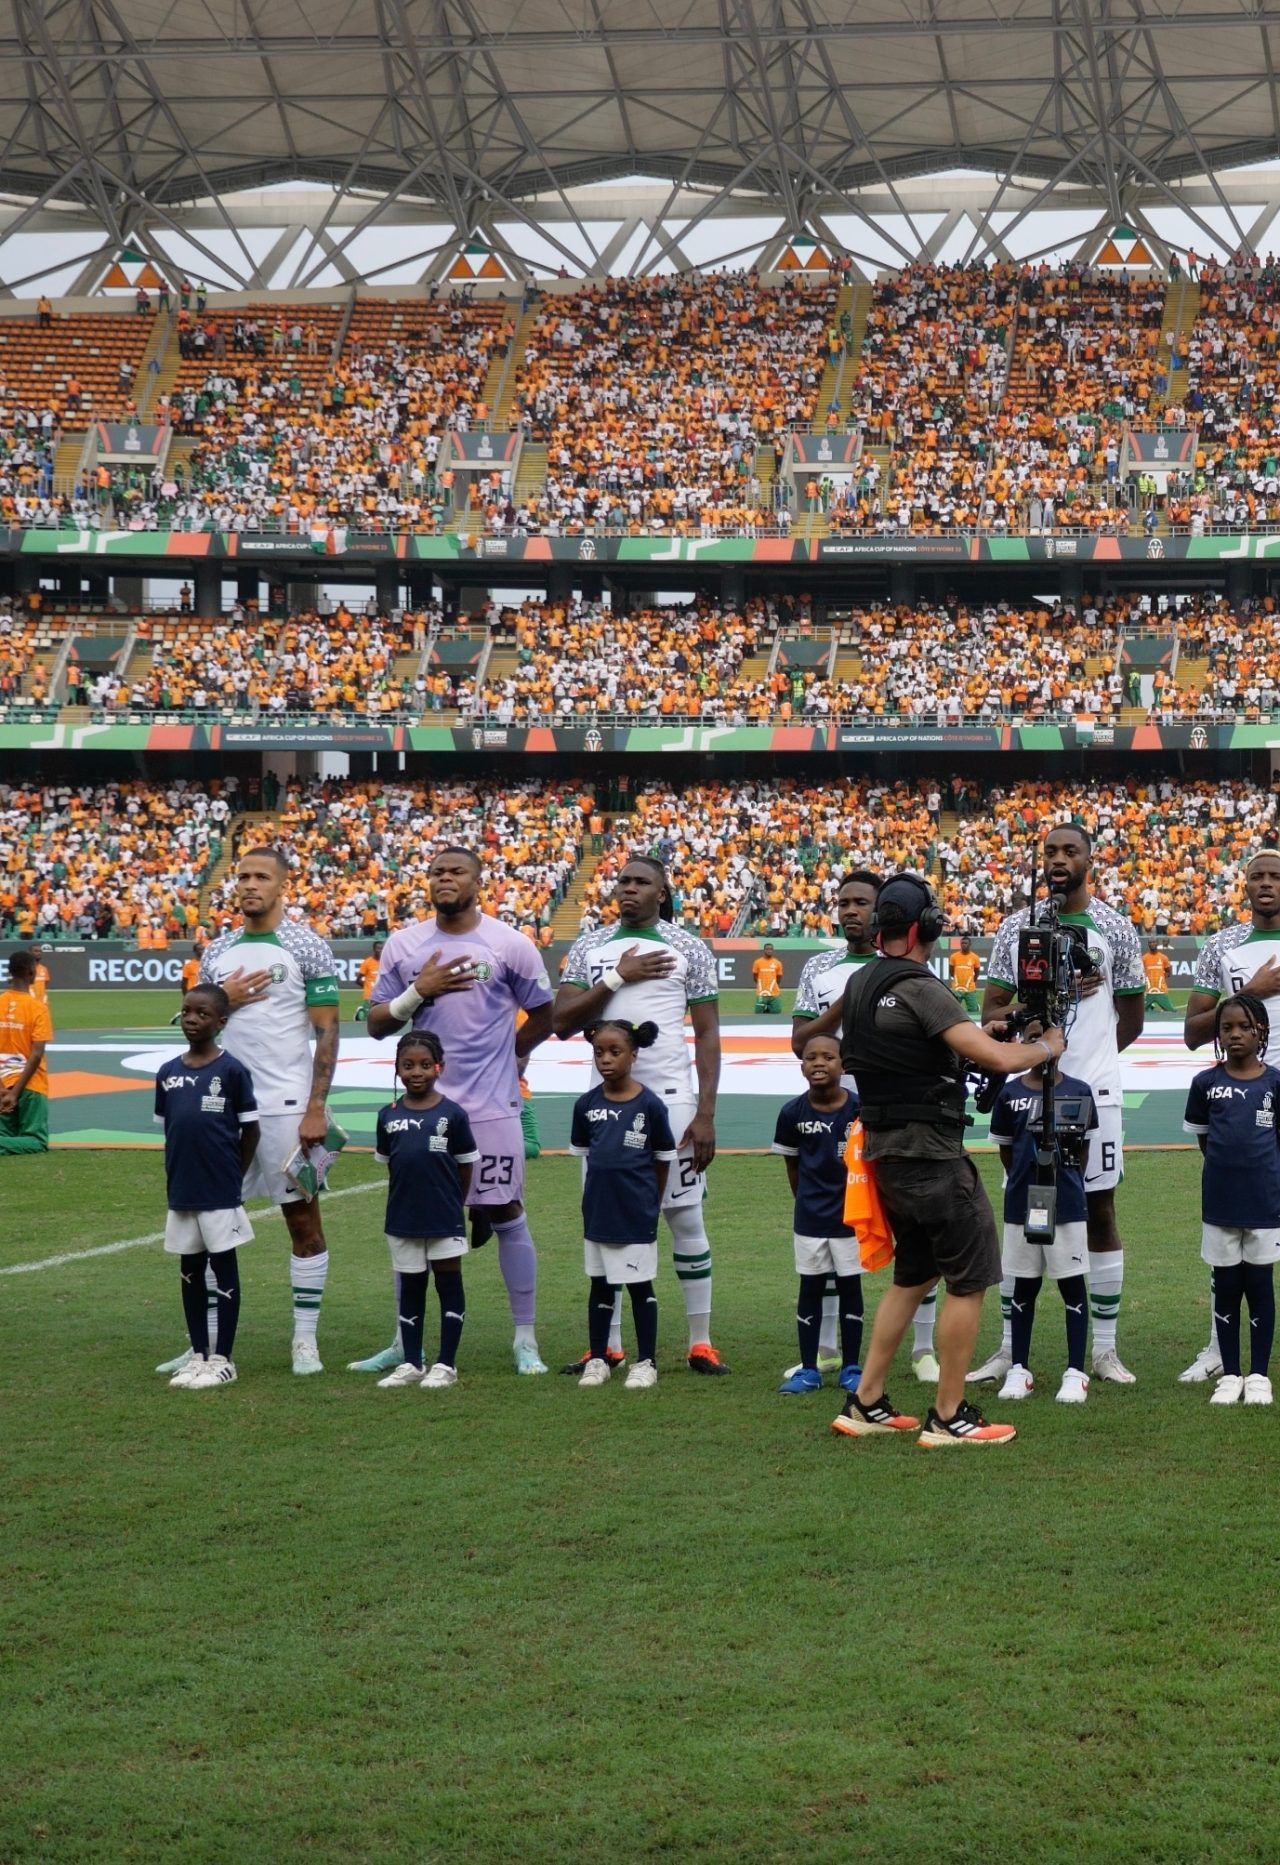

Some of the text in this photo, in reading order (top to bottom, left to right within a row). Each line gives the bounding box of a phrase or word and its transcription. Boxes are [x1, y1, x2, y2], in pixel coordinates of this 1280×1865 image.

[89, 959, 183, 982] RECOG
[1102, 1140, 1116, 1172] 6
[480, 1155, 514, 1185] 23
[848, 1172, 868, 1185] Ora
